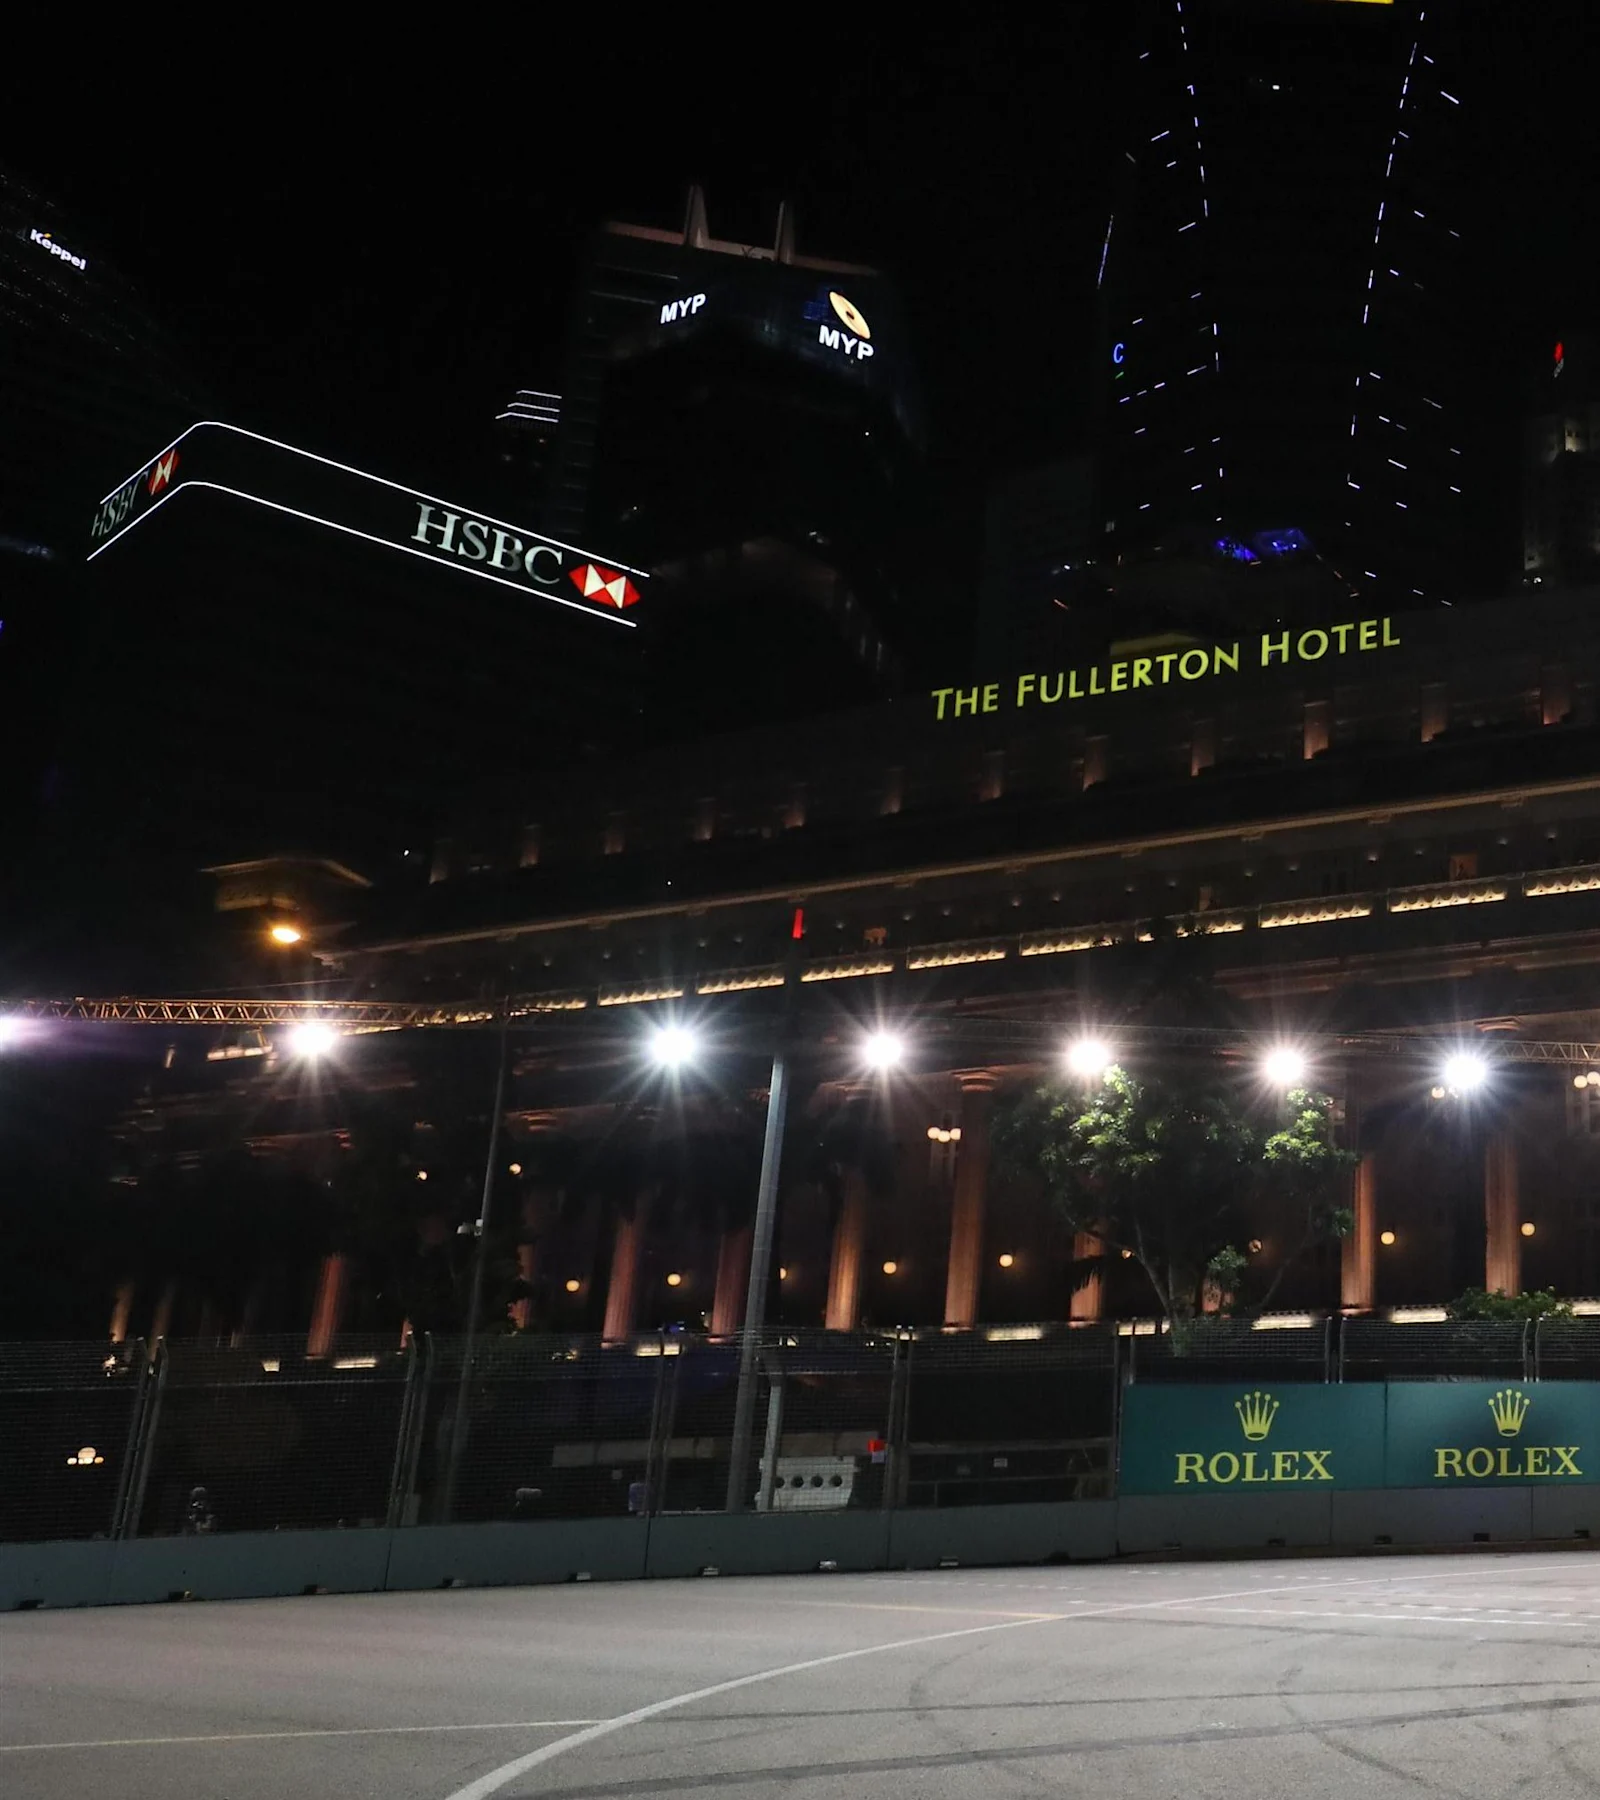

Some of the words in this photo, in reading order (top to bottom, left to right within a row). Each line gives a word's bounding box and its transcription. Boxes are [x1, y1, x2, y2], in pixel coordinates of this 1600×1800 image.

[30, 228, 87, 271] Keppel
[660, 293, 707, 324] MYP
[818, 324, 874, 361] MYP
[91, 469, 150, 538] HSBC
[410, 502, 566, 586] HSBC
[932, 685, 1000, 720] THE
[1017, 642, 1241, 707] FULLERTON
[1260, 617, 1401, 667] HOTEL
[1174, 1451, 1334, 1484] ROLEX
[1434, 1447, 1583, 1479] ROLEX
